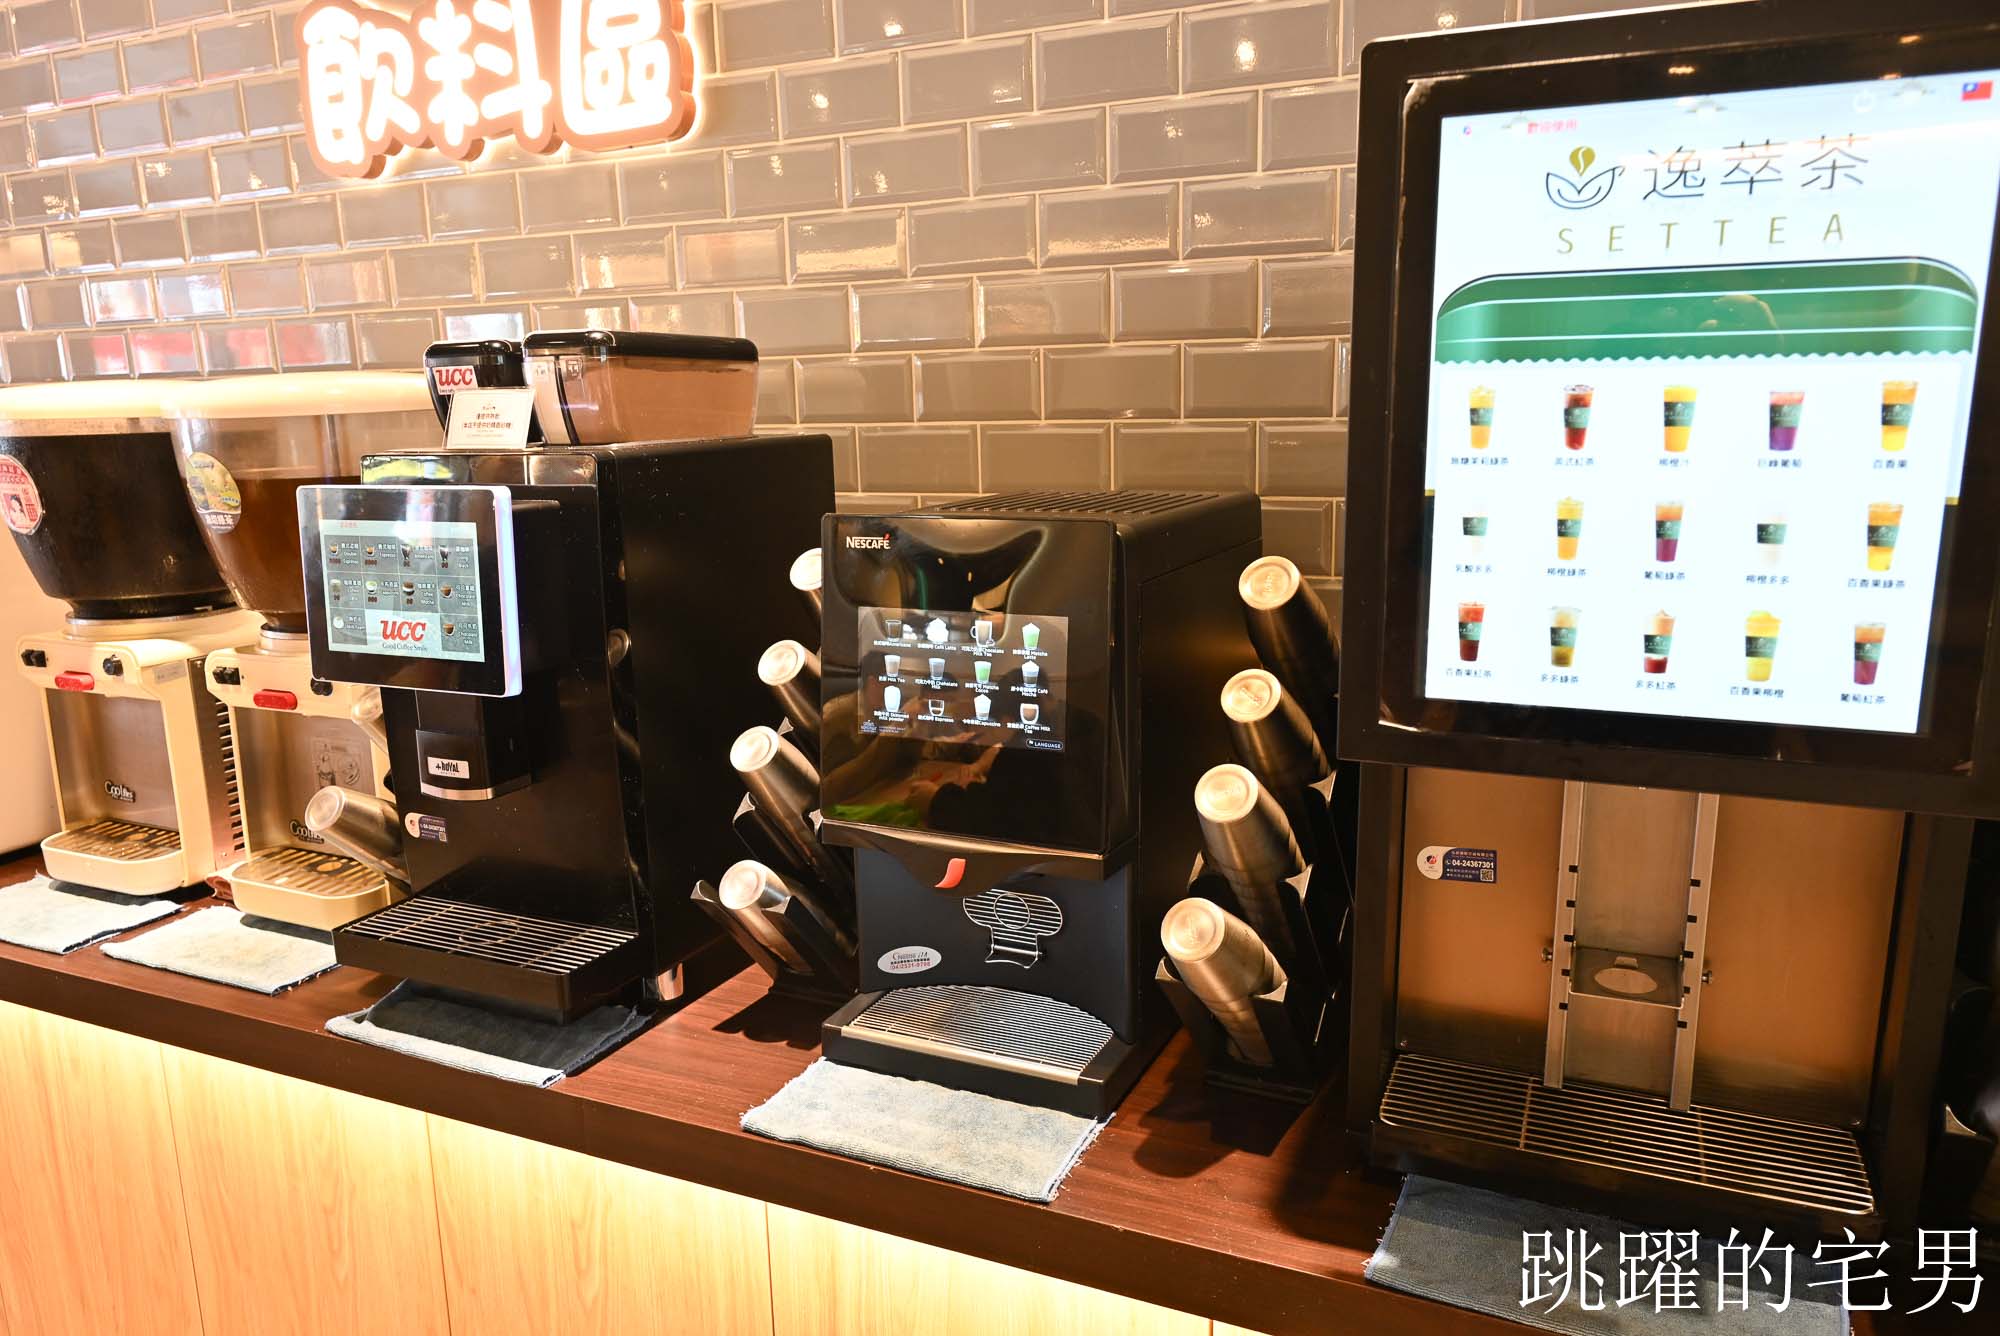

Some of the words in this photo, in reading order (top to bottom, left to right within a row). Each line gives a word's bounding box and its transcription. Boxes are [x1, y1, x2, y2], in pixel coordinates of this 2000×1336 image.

[303, 0, 673, 164] 飲料區
[1643, 132, 1871, 201] 逸萃茶
[1556, 213, 1845, 255] SETTEA
